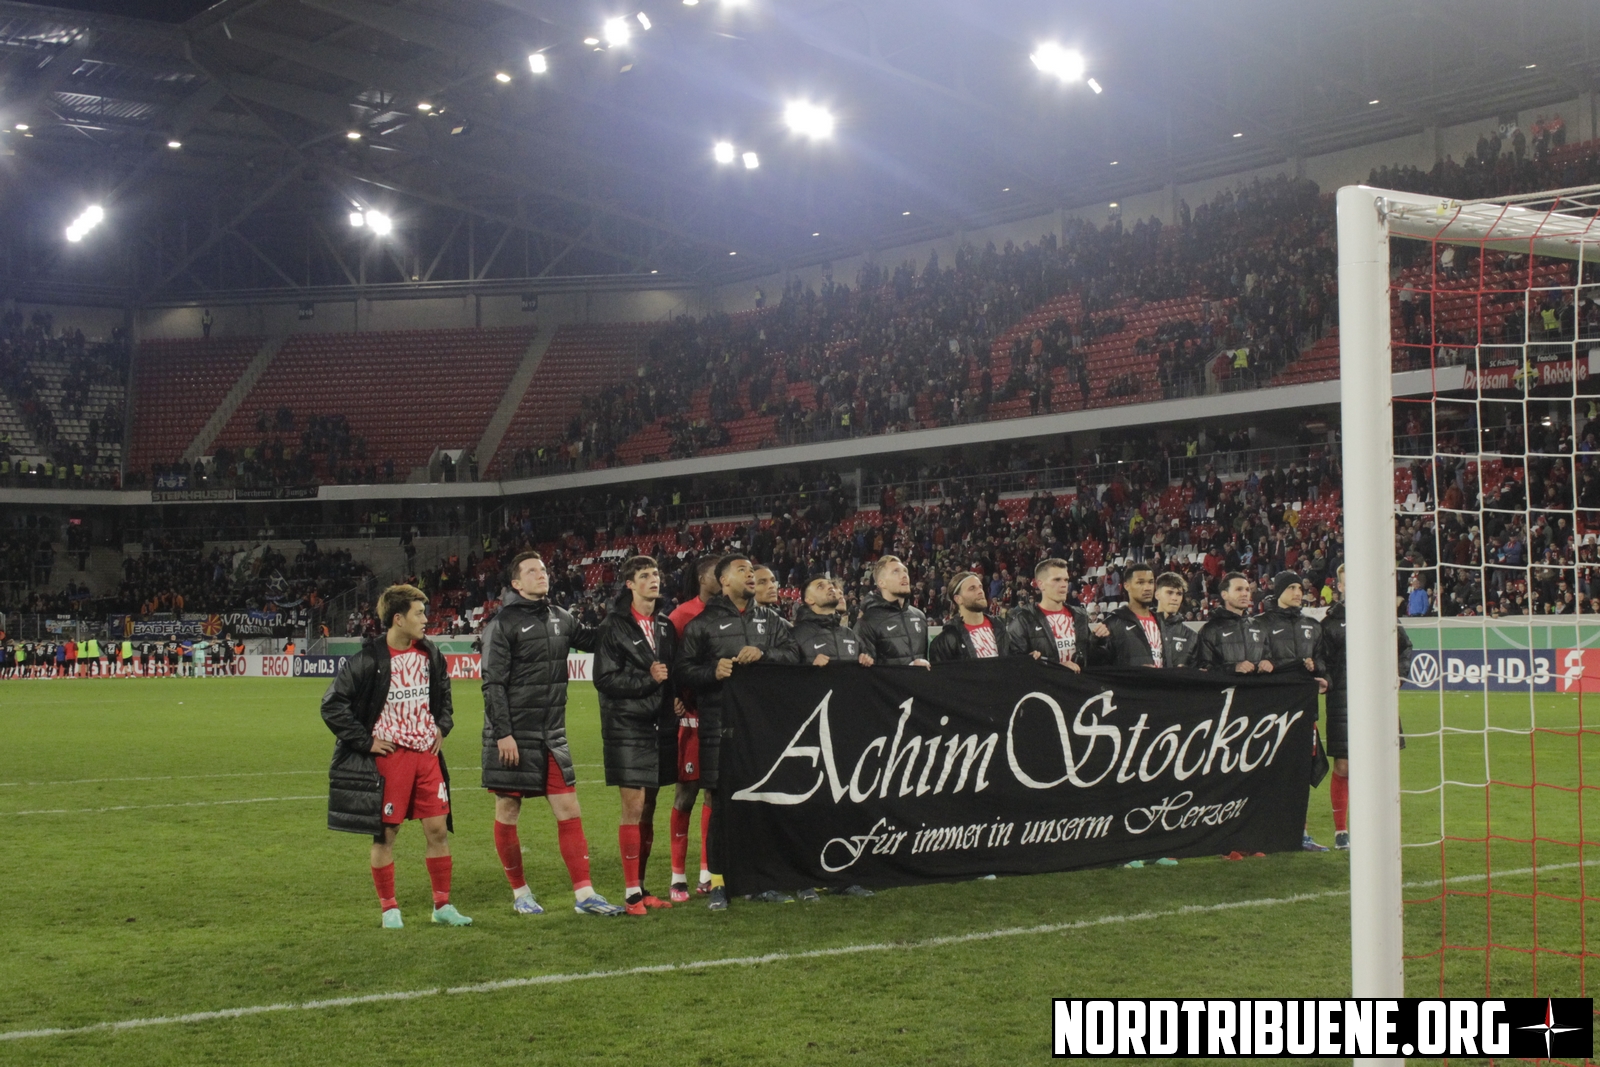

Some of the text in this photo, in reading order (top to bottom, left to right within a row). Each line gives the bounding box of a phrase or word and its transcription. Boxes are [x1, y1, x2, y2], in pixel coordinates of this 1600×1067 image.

[153, 489, 233, 501] STEINHAUSEN
[262, 656, 290, 676] ERGO
[304, 659, 318, 674] Der
[318, 659, 335, 674] ID.3
[1447, 657, 1492, 684] Der
[1498, 657, 1550, 685] ID.3
[388, 686, 430, 701] JOBRAD
[731, 685, 1304, 805] Achim Stocker
[911, 822, 988, 855] immer
[987, 816, 1014, 848] in
[1020, 814, 1114, 846] unserm
[1124, 790, 1249, 835] Herzen
